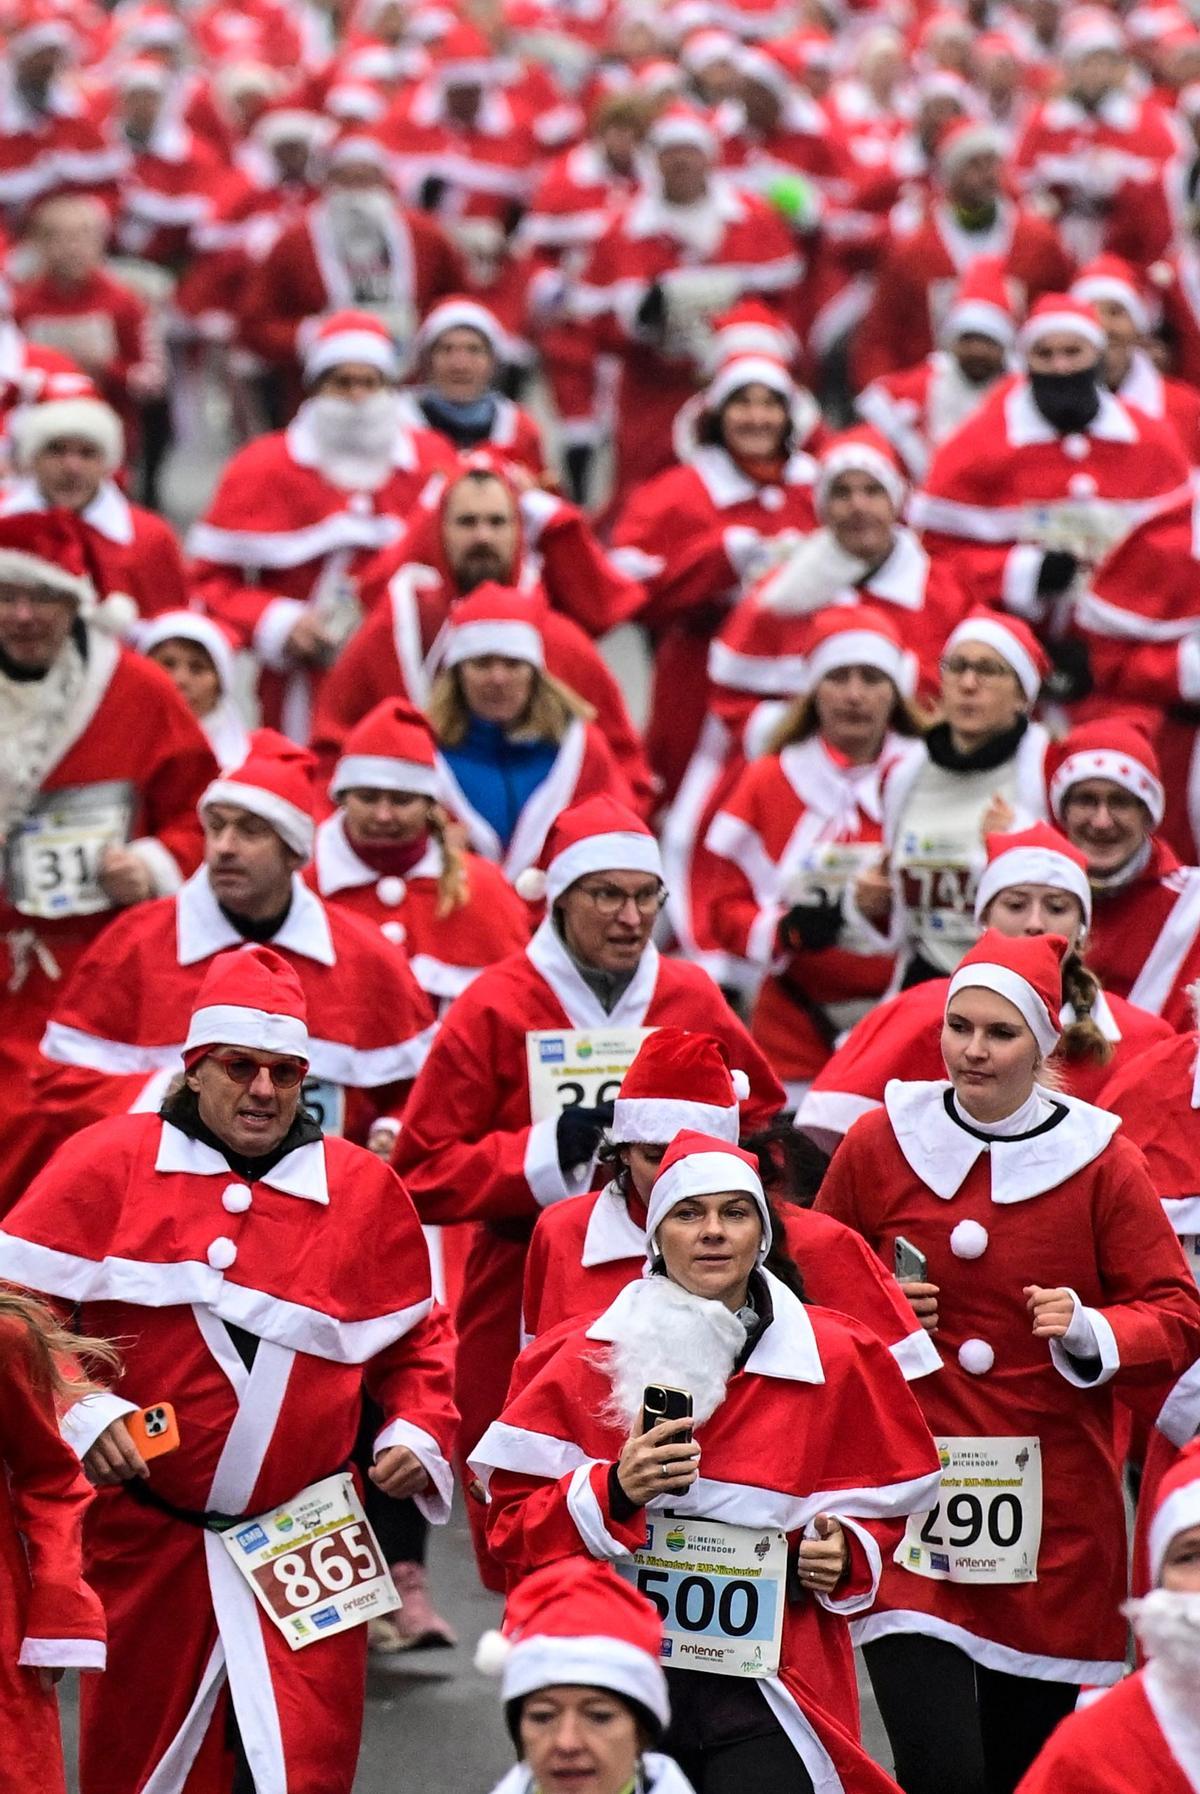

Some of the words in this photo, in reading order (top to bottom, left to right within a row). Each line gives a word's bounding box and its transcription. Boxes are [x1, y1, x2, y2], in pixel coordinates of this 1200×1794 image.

[920, 1493, 1023, 1547] 290
[687, 1535, 726, 1546] GEMEINDE
[687, 1545, 736, 1555] MICHENDORF
[272, 1524, 378, 1608] 865
[955, 1557, 997, 1568] Antenne
[637, 1568, 759, 1637] 500
[680, 1644, 724, 1658] Antenne
